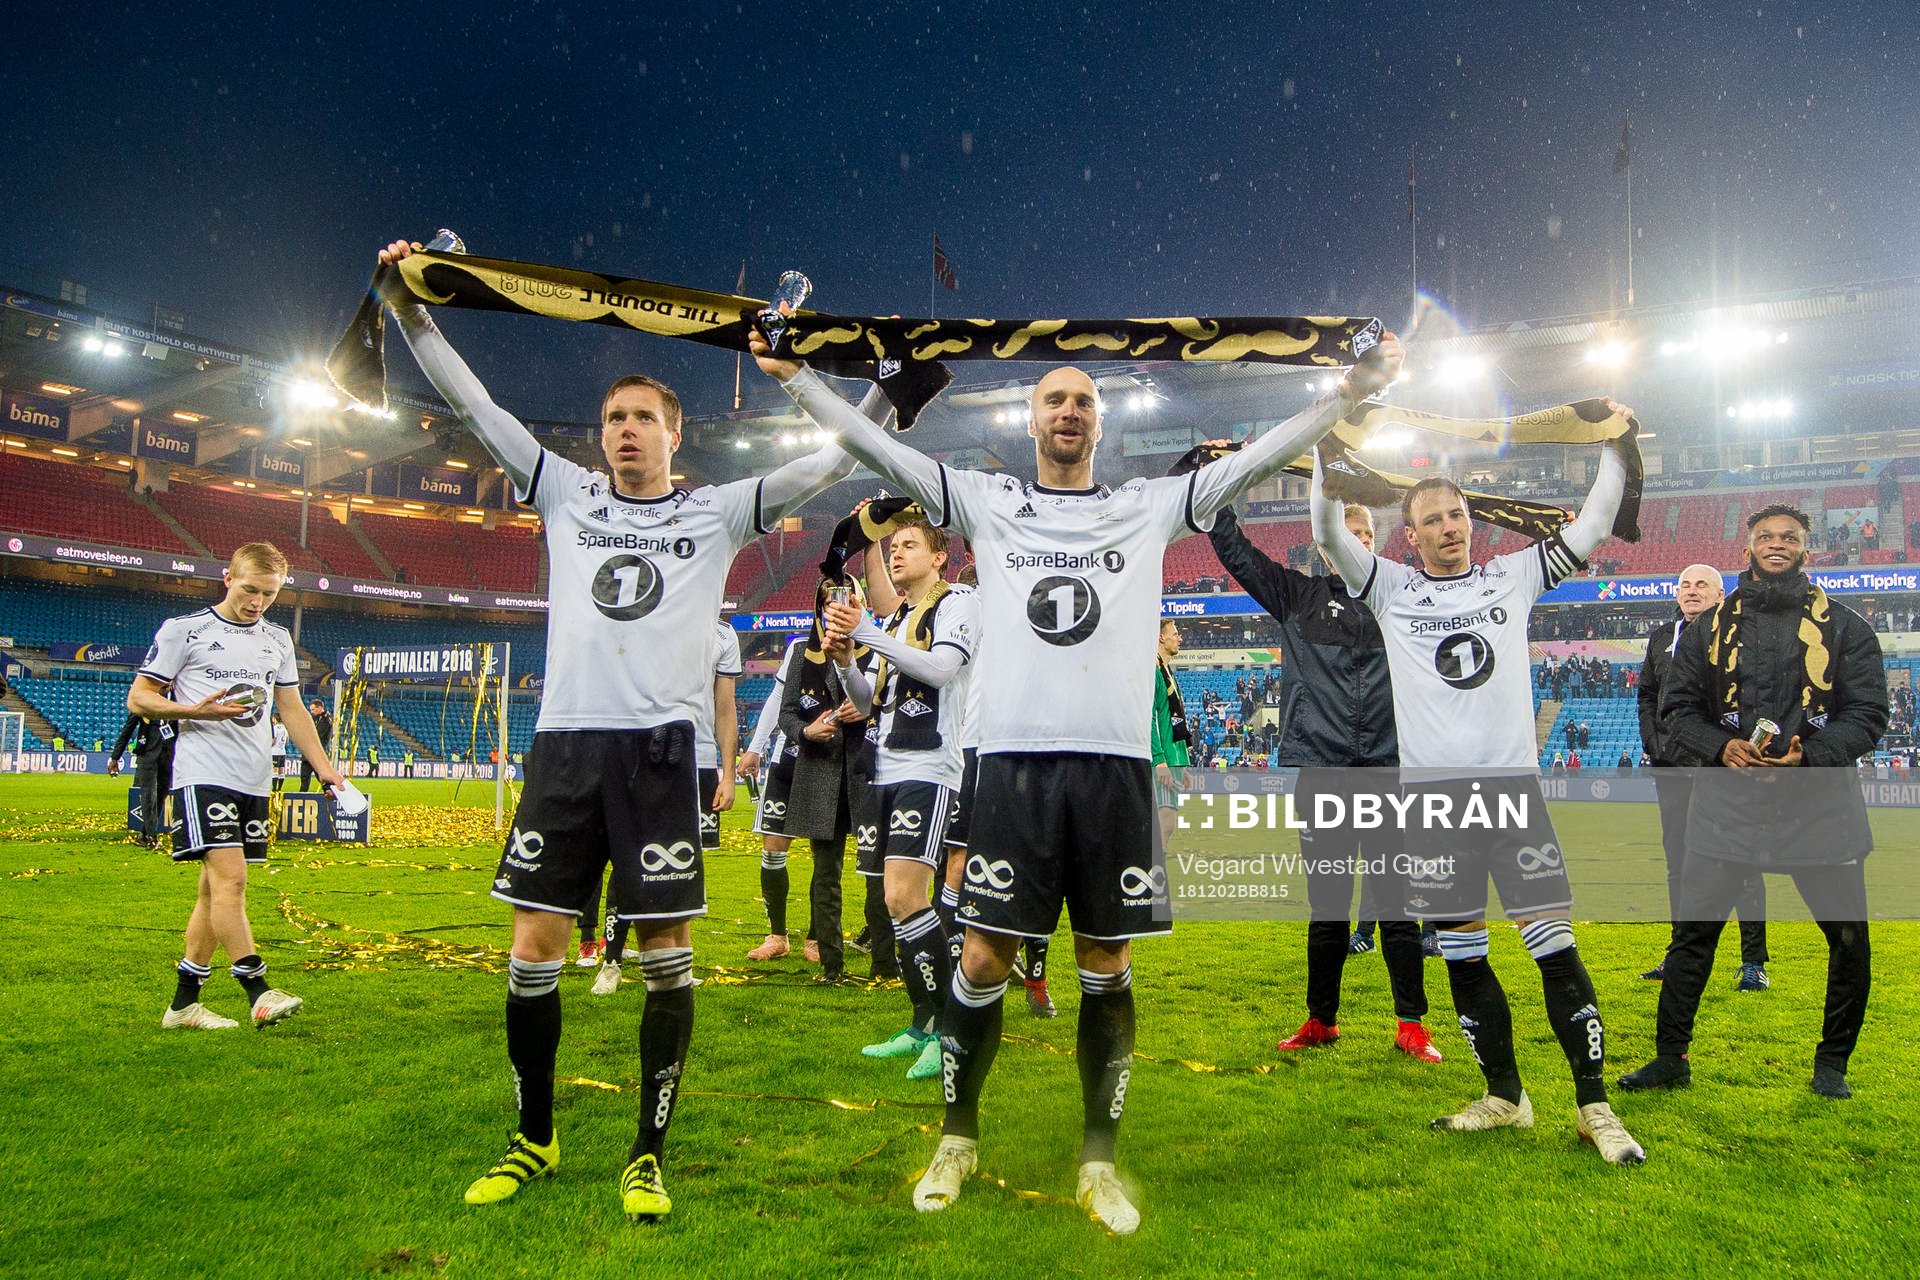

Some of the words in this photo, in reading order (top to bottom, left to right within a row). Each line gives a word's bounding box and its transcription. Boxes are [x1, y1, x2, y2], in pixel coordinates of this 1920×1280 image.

[183, 342, 196, 352] OG
[197, 344, 242, 363] AKTIVITET
[9, 402, 61, 429] bama
[145, 430, 191, 454] bama
[262, 454, 301, 475] bama
[420, 476, 462, 495] bama
[1664, 477, 1694, 489] Tipping
[1530, 486, 1559, 498] Tipping
[1014, 511, 1037, 519] adidas
[1271, 504, 1289, 513] Norsk
[577, 530, 672, 554] SpareBank
[56, 546, 143, 566] eatmovesleep.no
[1005, 551, 1101, 572] SpareBank
[171, 560, 195, 573] bama
[1435, 581, 1474, 593] Scandic
[1620, 583, 1658, 597] Norsk
[1816, 575, 1859, 590] Norsk
[1860, 573, 1918, 591] Tipping
[352, 582, 422, 600] eatmovesleep.no
[448, 593, 469, 604] bama
[1168, 602, 1205, 615] Tipping
[765, 617, 789, 627] Norsk
[1410, 612, 1489, 636] SpareBank
[223, 626, 257, 637] Scandic
[87, 645, 121, 662] Bendit
[364, 650, 439, 675] CUPFINALEN
[441, 649, 474, 672] 2018
[205, 668, 261, 681] SpareBan
[57, 753, 88, 772] 2018
[413, 762, 432, 778] MED
[475, 764, 494, 779] 2018
[335, 819, 359, 830] REMA
[337, 830, 356, 840] 1000
